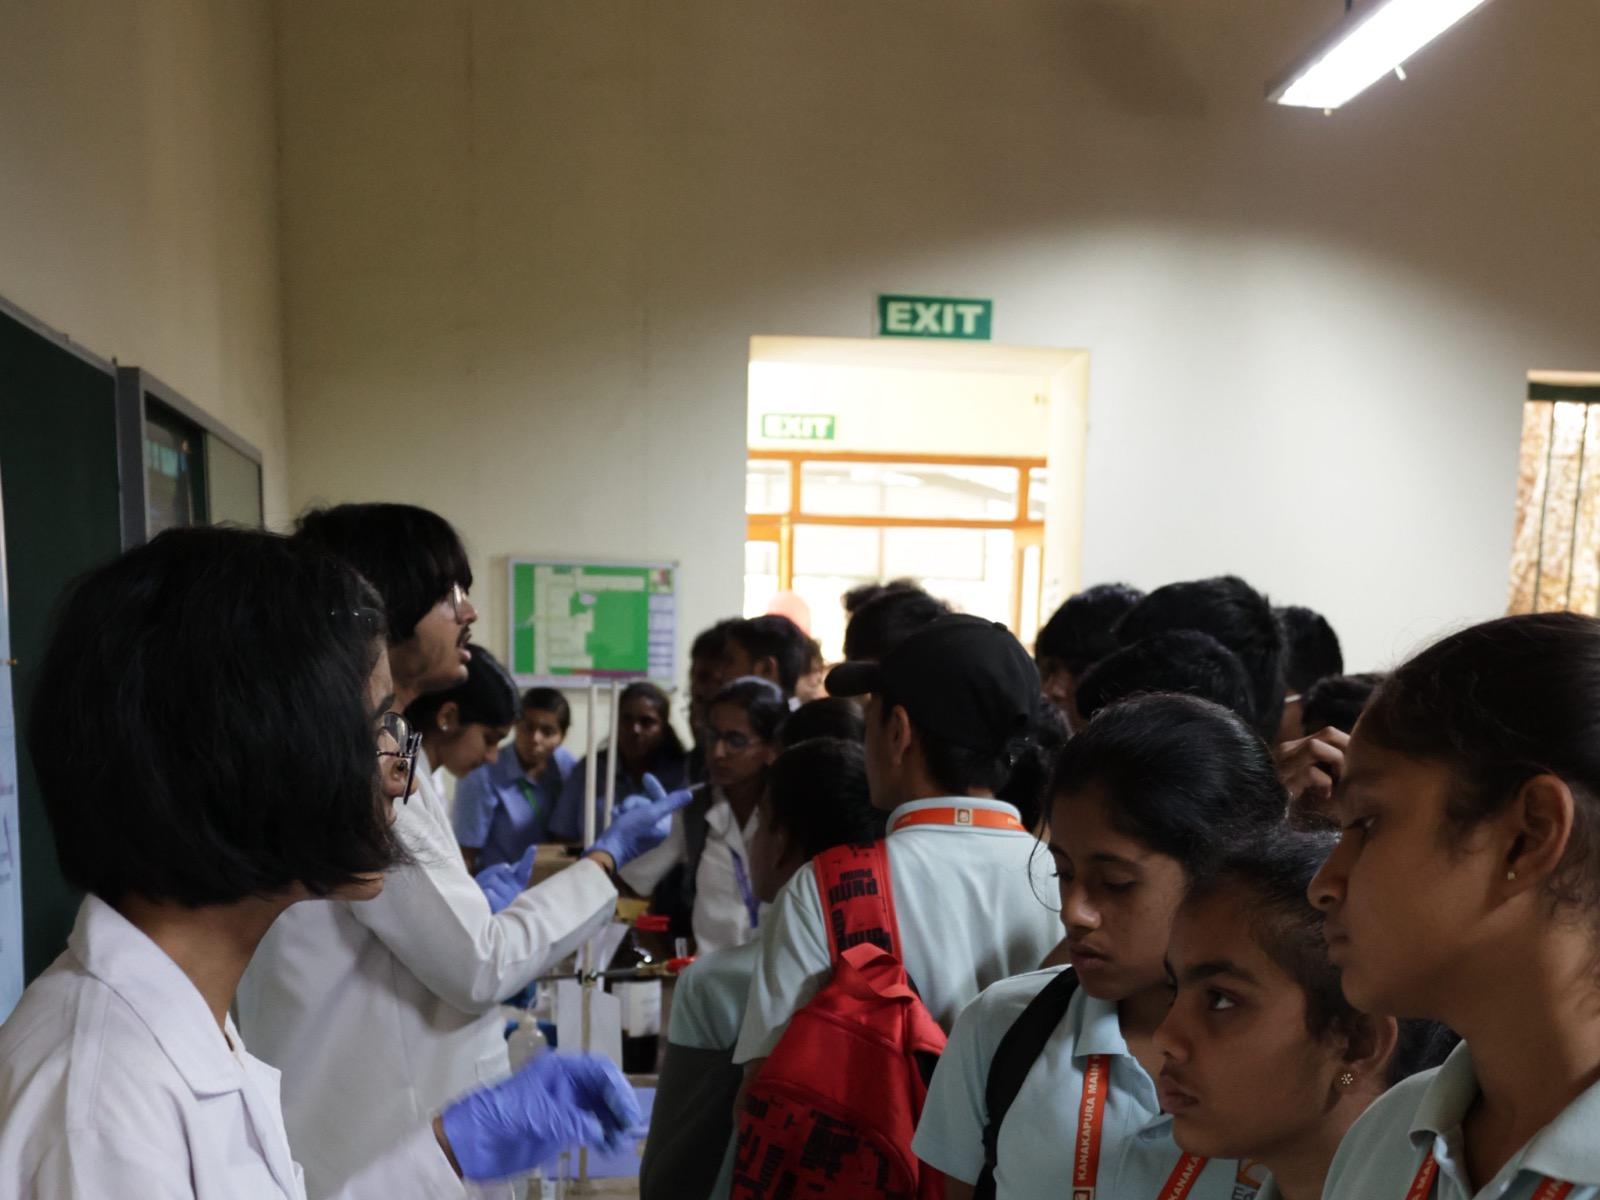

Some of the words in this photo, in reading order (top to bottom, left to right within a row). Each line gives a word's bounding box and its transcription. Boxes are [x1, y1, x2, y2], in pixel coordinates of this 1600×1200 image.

[885, 300, 984, 335] EXIT
[766, 415, 830, 439] EXIT
[1077, 1096, 1095, 1181] KANAKAPURA
[1087, 1063, 1100, 1095] MAIN
